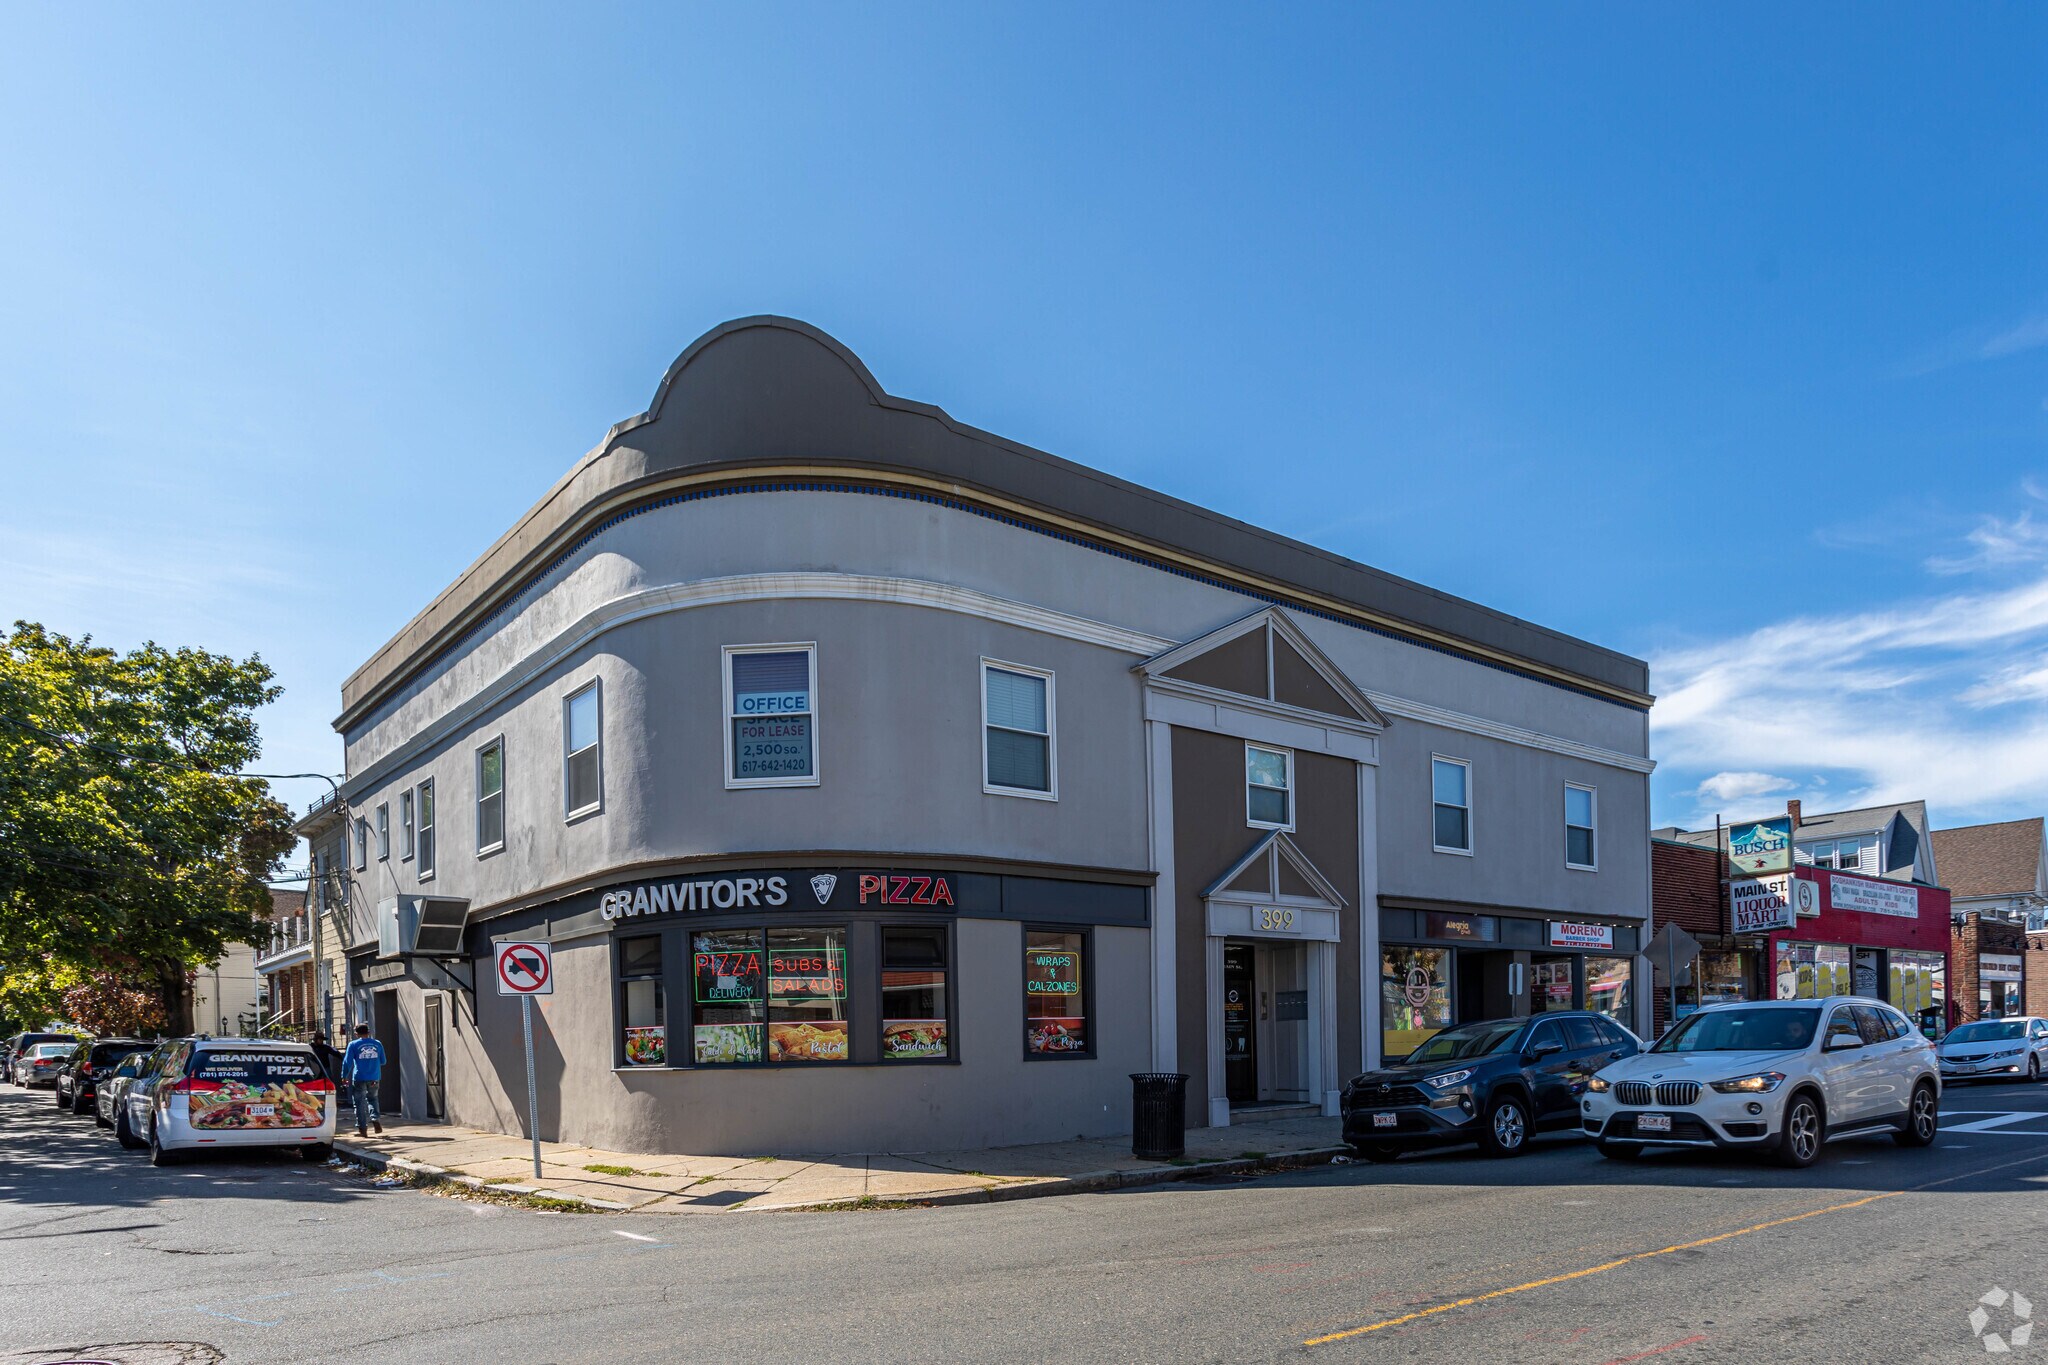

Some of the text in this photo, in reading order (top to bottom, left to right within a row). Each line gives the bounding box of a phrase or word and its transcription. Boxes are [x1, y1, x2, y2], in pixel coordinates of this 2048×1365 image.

[743, 696, 805, 711] OFFICE
[742, 725, 805, 738] FOR LEASE
[743, 744, 783, 758] 2,500
[742, 759, 805, 772] 617-642-1420
[1733, 838, 1785, 856] BUSCH
[1734, 881, 1788, 898] MAIN ST.
[1865, 881, 1886, 891] MARTIAL
[1899, 887, 1916, 895] CENTER
[600, 874, 954, 921] GRANVITOR'S PIZZA
[1736, 895, 1786, 914] LIQUOR
[1854, 897, 1899, 908] ADULTS KIDS
[1261, 909, 1294, 930] 399
[1737, 909, 1780, 926] MART
[1560, 924, 1605, 937] MORENO
[695, 953, 761, 977] PIZZA
[774, 958, 840, 972] SUBS &
[1036, 956, 1071, 967] WRAPS
[773, 978, 845, 992] SALADS
[1028, 980, 1077, 992] CALZONES
[709, 986, 754, 999] DELIVERY
[892, 1038, 943, 1053] Sandwich
[1061, 1037, 1085, 1050] Pizza
[209, 1054, 305, 1064] GRANVITOR'S
[267, 1065, 314, 1076] PIZZA
